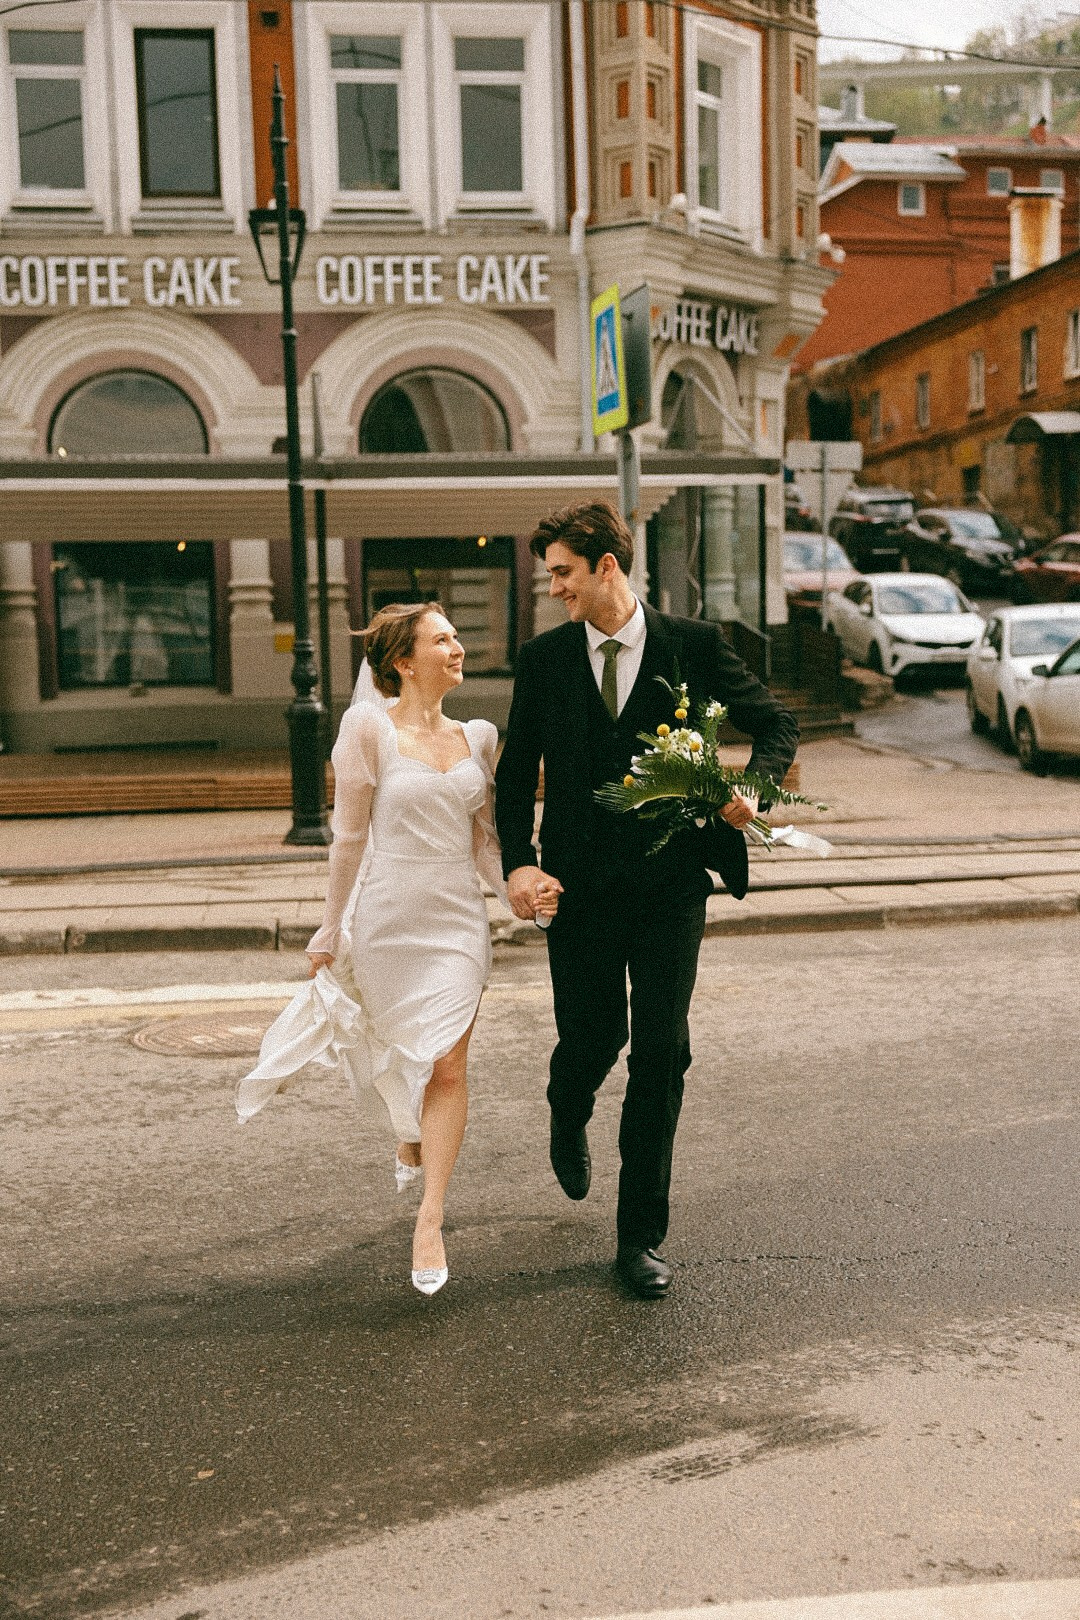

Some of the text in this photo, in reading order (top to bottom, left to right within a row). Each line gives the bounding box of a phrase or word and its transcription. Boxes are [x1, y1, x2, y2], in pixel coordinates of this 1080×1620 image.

[0, 256, 242, 307] COFFEE CAKE
[316, 255, 550, 305] COFFEE CAKE
[715, 305, 759, 356] CAKE
